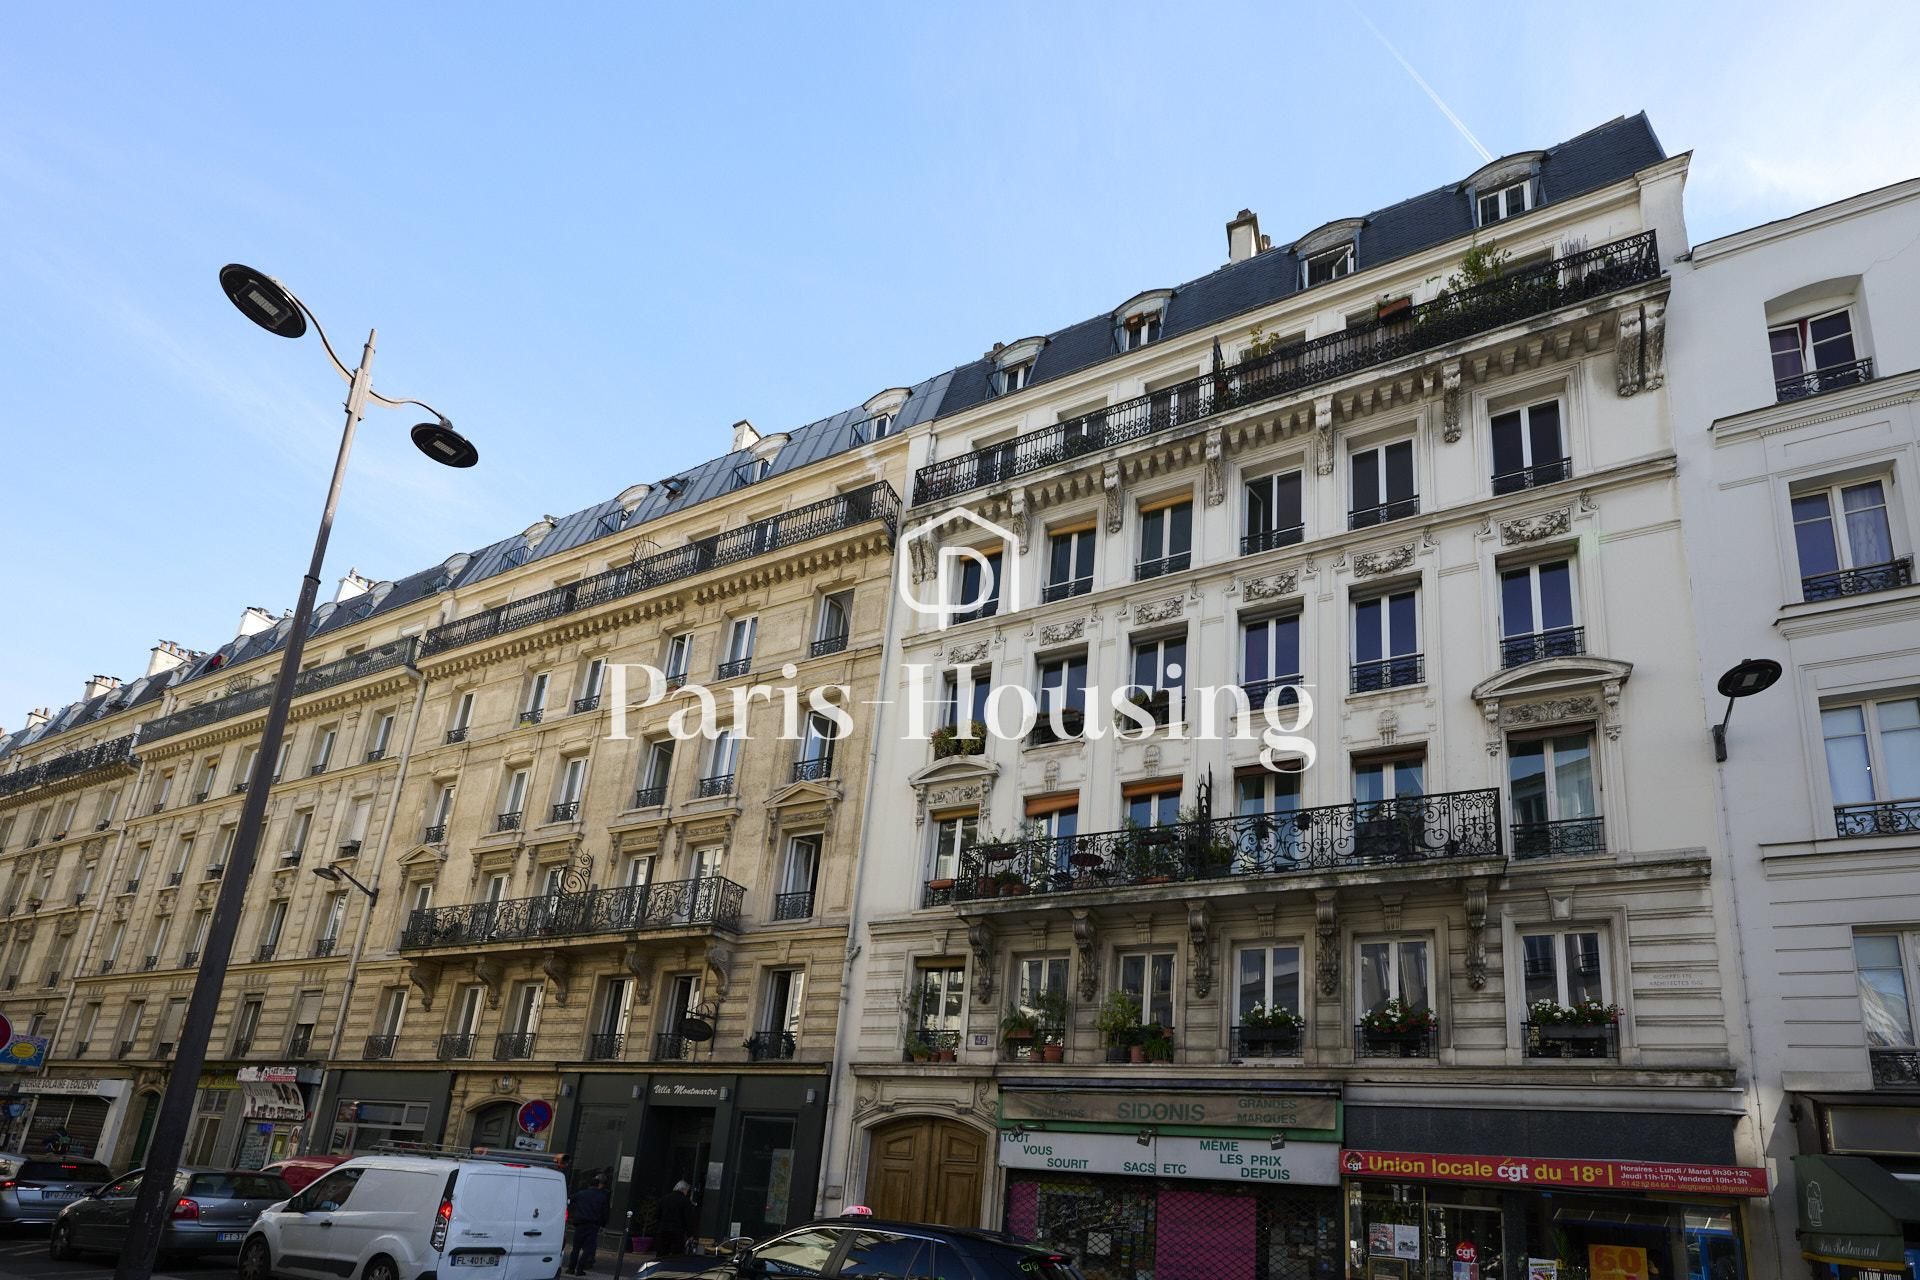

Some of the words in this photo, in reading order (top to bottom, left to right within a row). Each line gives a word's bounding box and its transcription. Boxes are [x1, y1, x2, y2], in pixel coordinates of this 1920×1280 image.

[975, 1036, 987, 1044] 42
[653, 1084, 671, 1094] Villa
[673, 1084, 718, 1097] Montmartre
[1237, 1098, 1297, 1110] GRANDES
[1117, 1102, 1205, 1122] SIDONIS
[1237, 1112, 1297, 1124] MARQUES
[1002, 1132, 1031, 1143] TOUT
[1023, 1145, 1053, 1156] VOUS
[1047, 1158, 1088, 1170] SOURIT
[1219, 1153, 1243, 1165] LES
[1250, 1155, 1281, 1167] PRIX
[1346, 1160, 1363, 1172] cgt
[1123, 1161, 1155, 1173] SACS
[1163, 1163, 1187, 1175] ETC
[1240, 1167, 1290, 1180] DEPUIS
[1368, 1155, 1425, 1174] Union
[1432, 1158, 1493, 1179] locale
[1496, 1163, 1529, 1182] cgt
[1534, 1164, 1565, 1182] du
[1569, 1164, 1604, 1183] 18e
[1620, 1164, 1654, 1173] Horaires
[1659, 1166, 1682, 1174] Lundi
[1688, 1167, 1711, 1175] Mardi
[1620, 1172, 1642, 1180] Jeudi
[1678, 1175, 1713, 1183] Vendredi
[1456, 1247, 1475, 1259] cgt
[1594, 1246, 1642, 1274] 60
